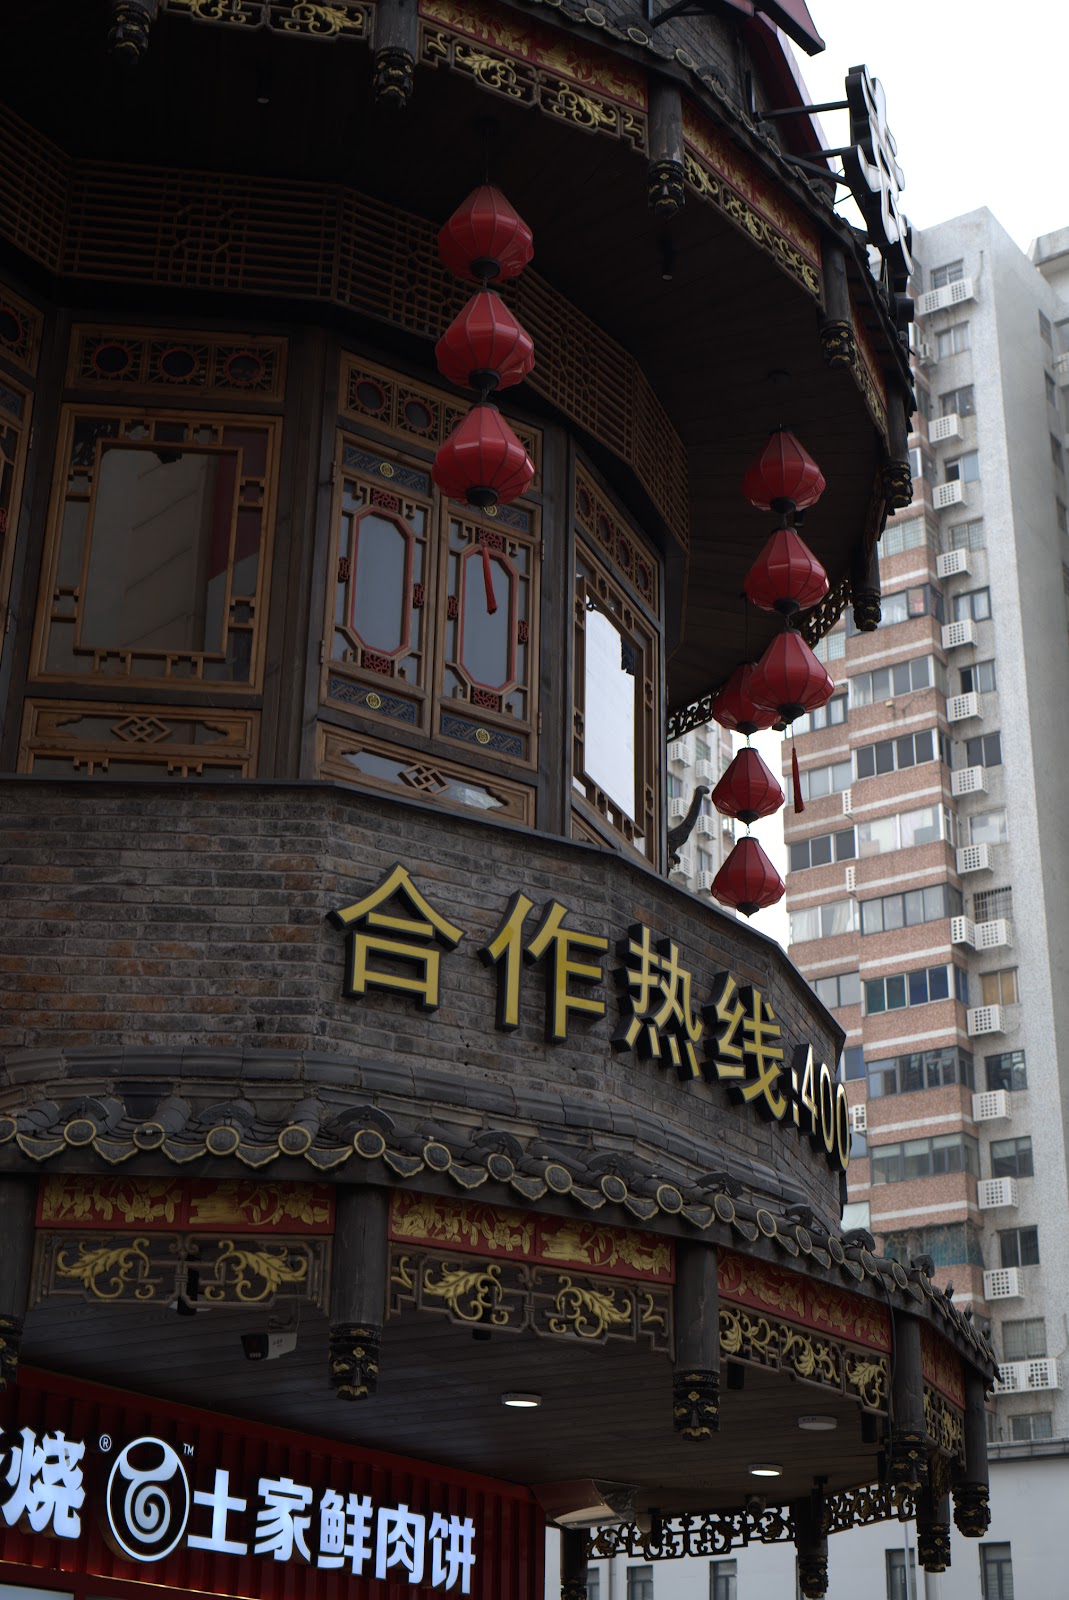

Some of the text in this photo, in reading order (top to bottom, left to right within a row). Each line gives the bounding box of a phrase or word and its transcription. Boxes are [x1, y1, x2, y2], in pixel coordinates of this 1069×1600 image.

[0, 1426, 86, 1539] 烧
[187, 1469, 477, 1594] 土家鲜肉饼
